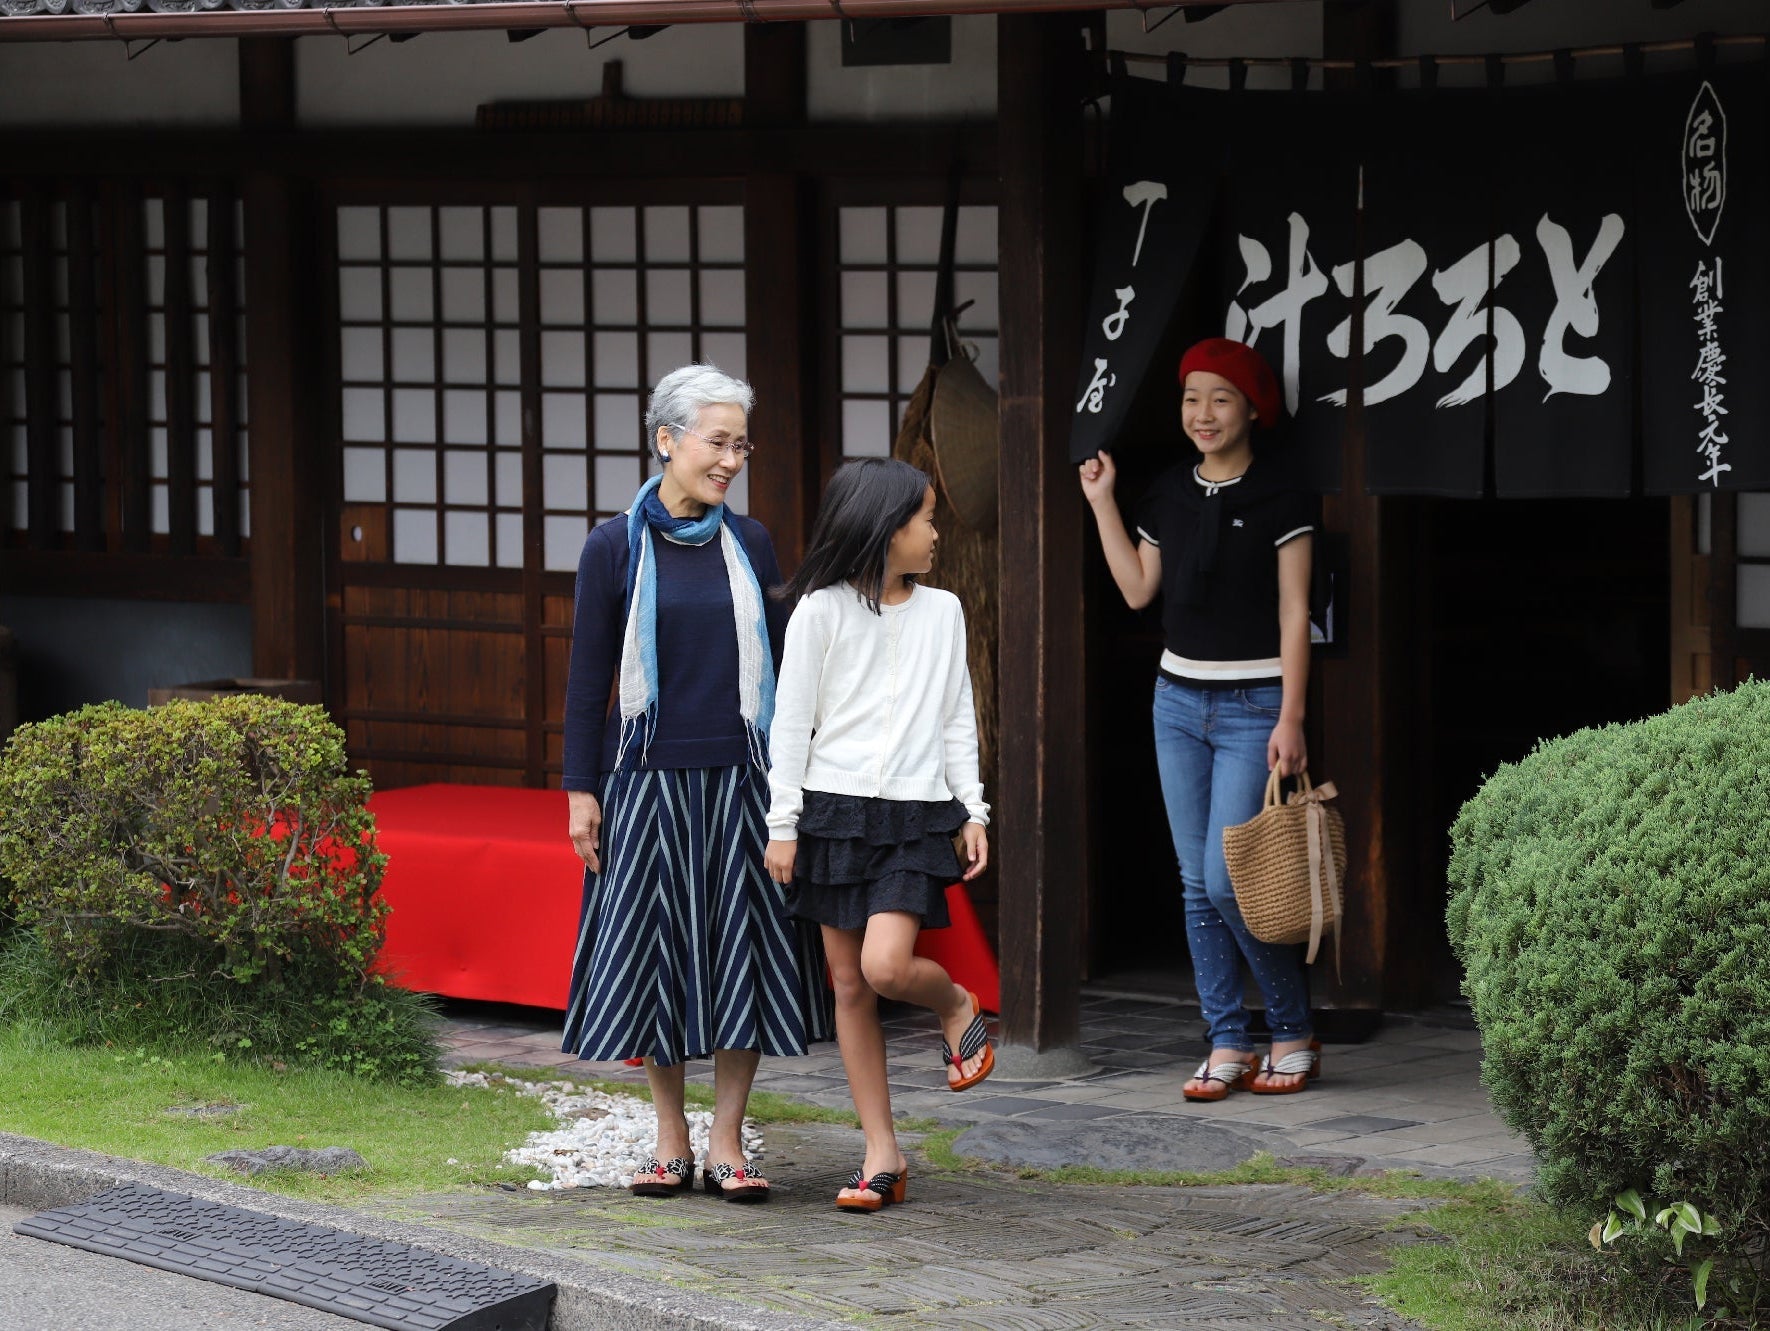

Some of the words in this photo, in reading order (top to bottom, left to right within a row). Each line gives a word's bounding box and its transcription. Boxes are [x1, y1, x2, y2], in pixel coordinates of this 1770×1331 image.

[1689, 109, 1722, 213] 名物
[1689, 256, 1732, 488] 創業慶長元年
